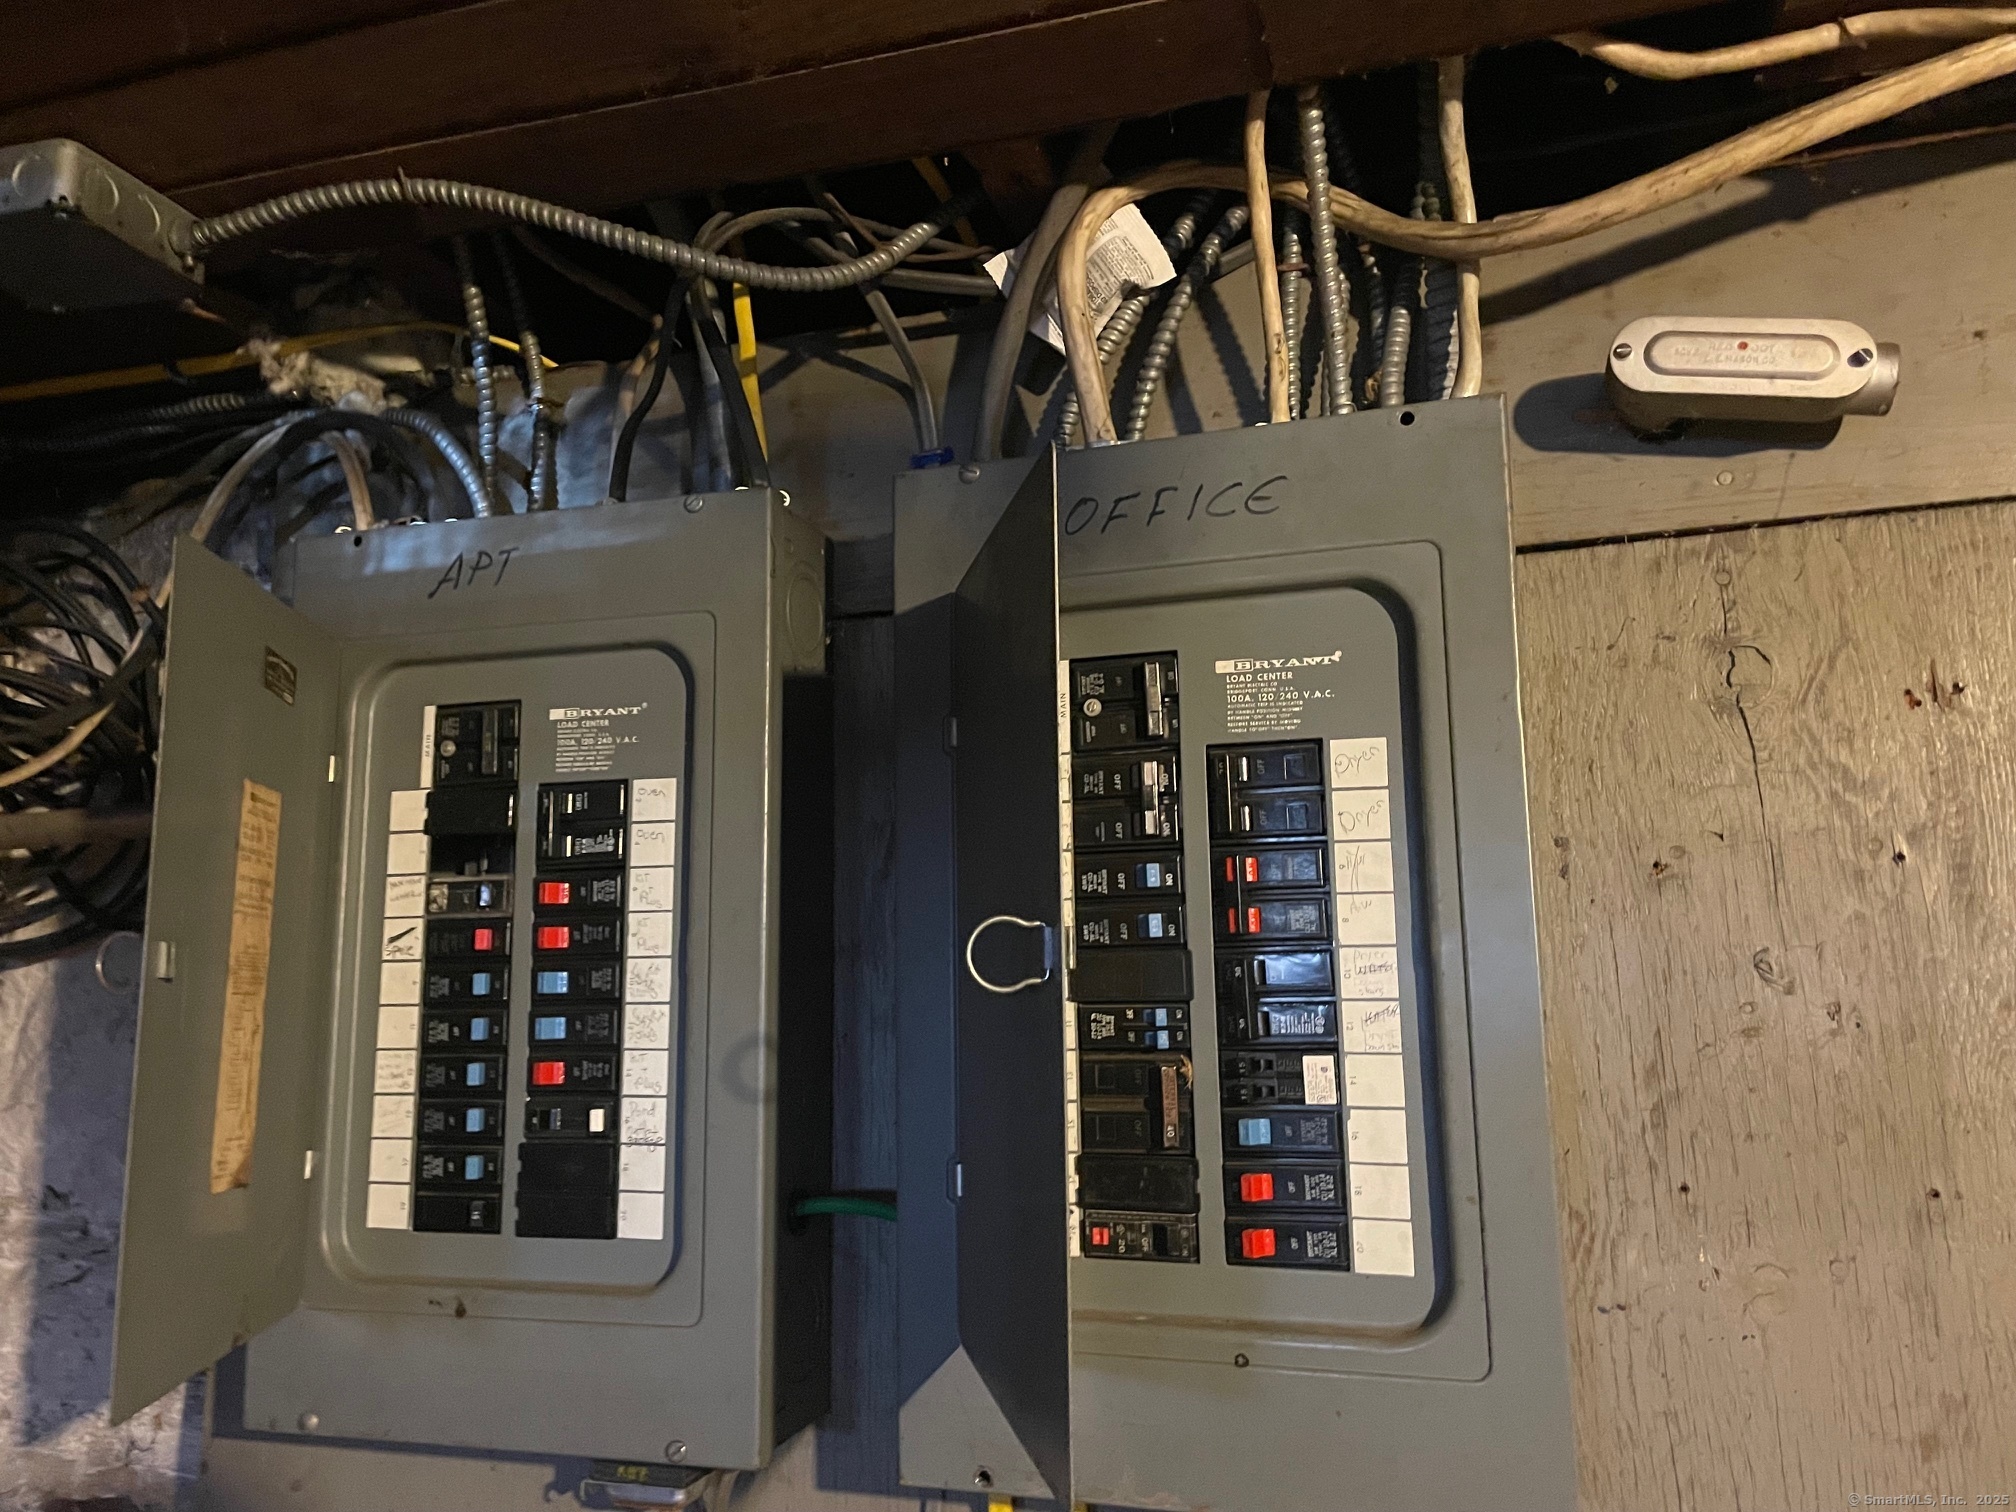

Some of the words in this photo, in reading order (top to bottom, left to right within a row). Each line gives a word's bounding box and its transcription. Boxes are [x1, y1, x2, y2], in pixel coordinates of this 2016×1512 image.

[1064, 475, 1288, 536] OFFICE
[428, 547, 520, 599] APT
[1233, 654, 1334, 672] BRYANT
[1226, 674, 1253, 683] LOAD
[1257, 671, 1294, 681] CENTER
[1303, 689, 1336, 699] V.A.C.
[564, 706, 642, 719] BRYANT
[581, 719, 610, 727] CENTER
[1257, 758, 1265, 774] OFF
[1114, 773, 1122, 791] OFF
[1117, 872, 1126, 890] OFF
[1165, 873, 1173, 886] ON
[1119, 922, 1128, 940] OFF
[1168, 923, 1176, 937] ON
